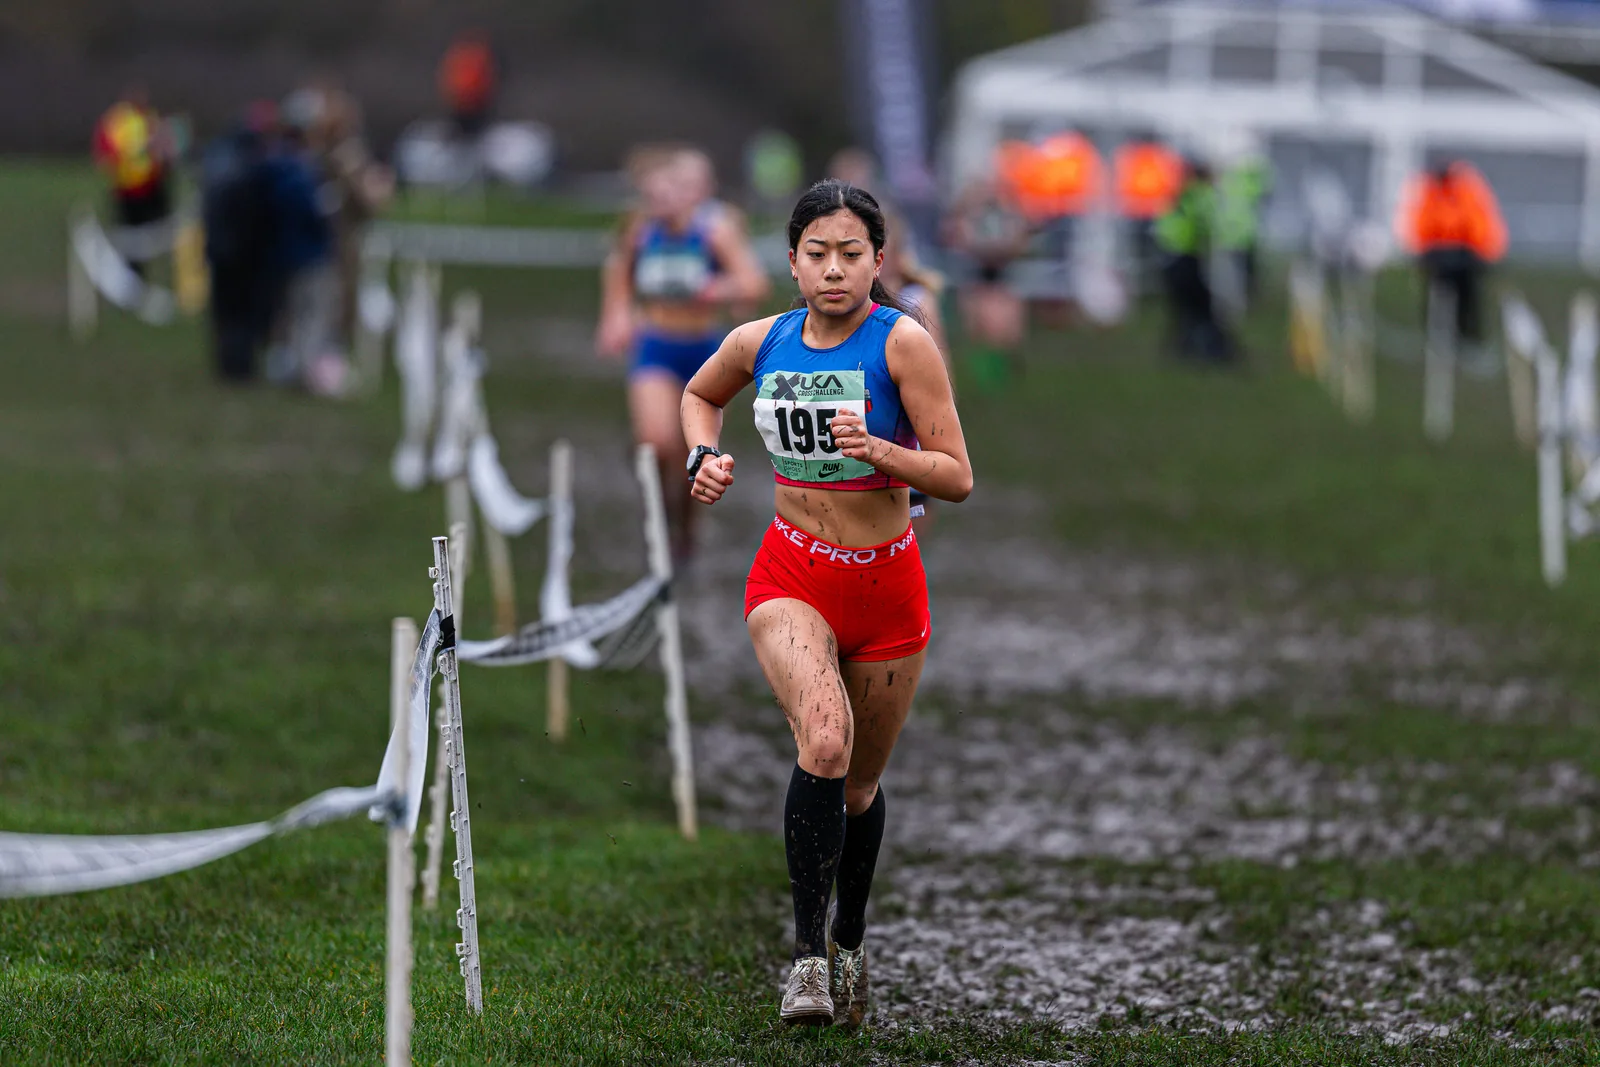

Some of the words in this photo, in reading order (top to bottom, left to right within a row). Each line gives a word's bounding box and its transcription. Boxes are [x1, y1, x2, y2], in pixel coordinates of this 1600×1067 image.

[800, 374, 844, 390] UKA
[774, 406, 841, 455] 195
[822, 462, 840, 471] RUN
[809, 540, 877, 564] PRO
